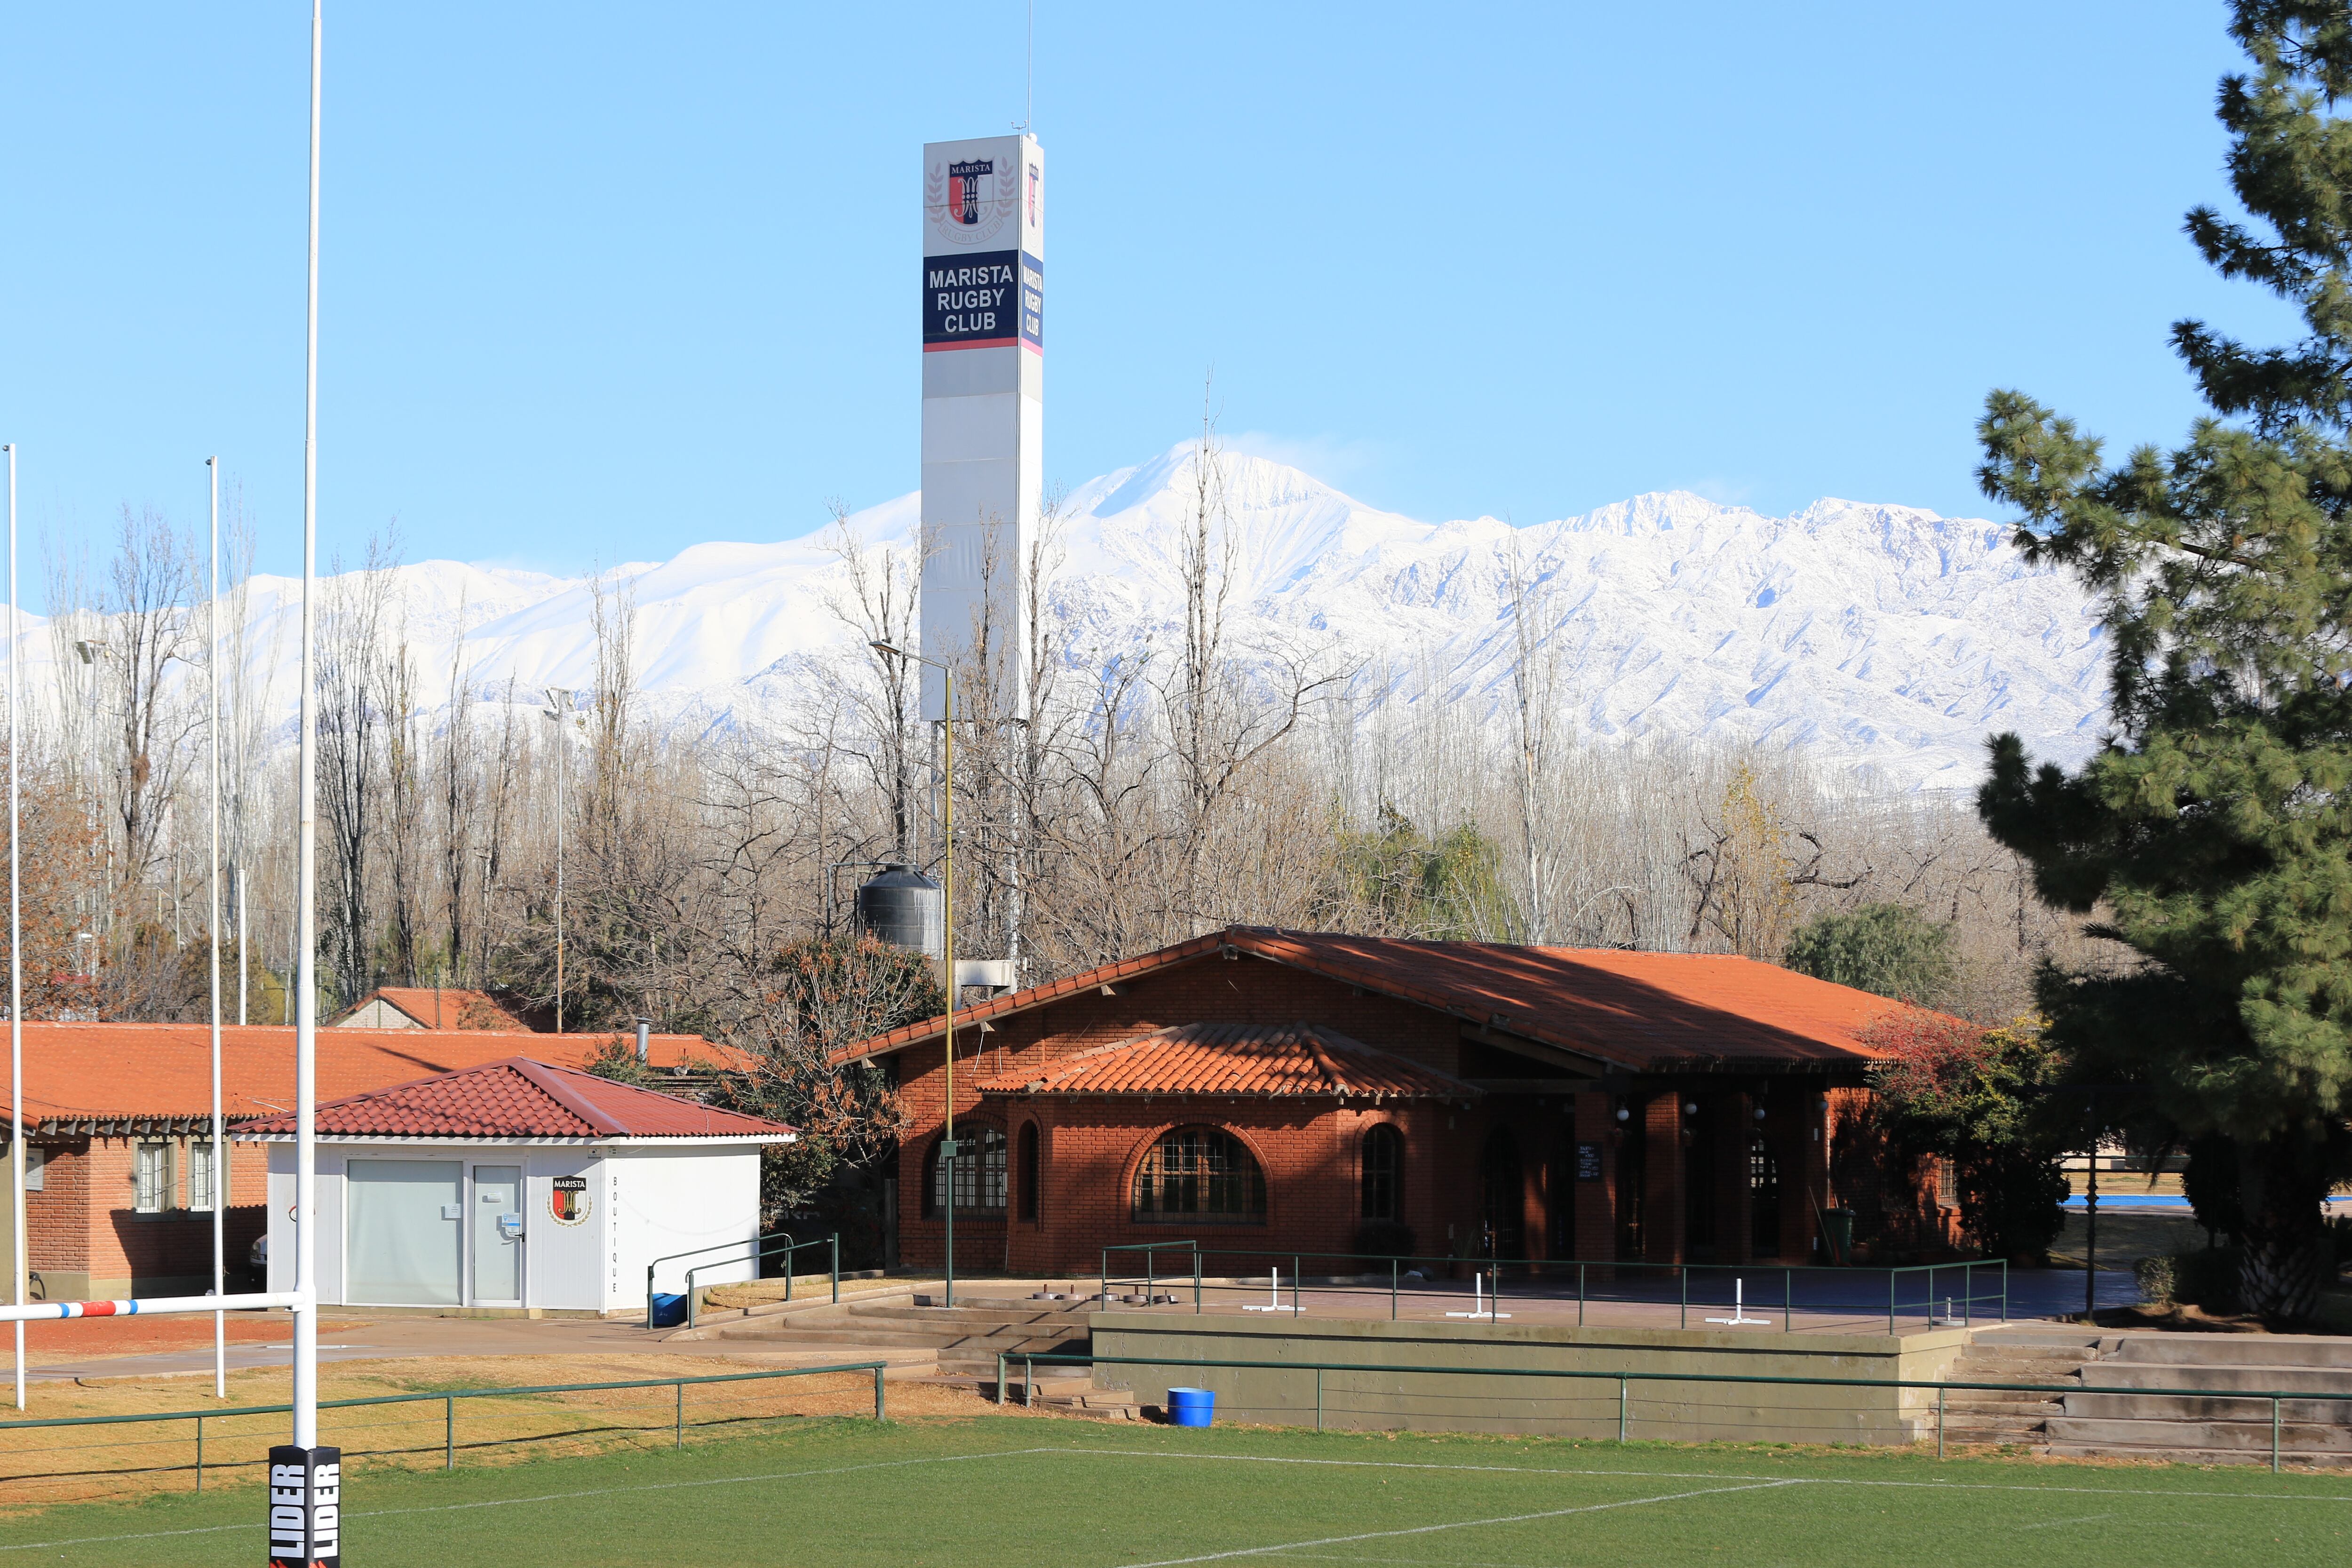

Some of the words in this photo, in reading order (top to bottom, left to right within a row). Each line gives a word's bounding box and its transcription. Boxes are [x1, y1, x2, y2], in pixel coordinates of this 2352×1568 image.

[951, 164, 991, 174] MARISTA
[942, 225, 972, 242] RUGBY
[976, 221, 1000, 240] CLUB
[930, 265, 1014, 288] MARISTA
[1023, 265, 1043, 294] MARISTA
[938, 288, 1005, 310] RUGBY
[1025, 289, 1041, 314] RUGBY
[945, 312, 996, 333] CLUB
[1026, 313, 1039, 337] CLUB
[271, 1464, 305, 1558] LIDER
[314, 1463, 340, 1558] LIDER
